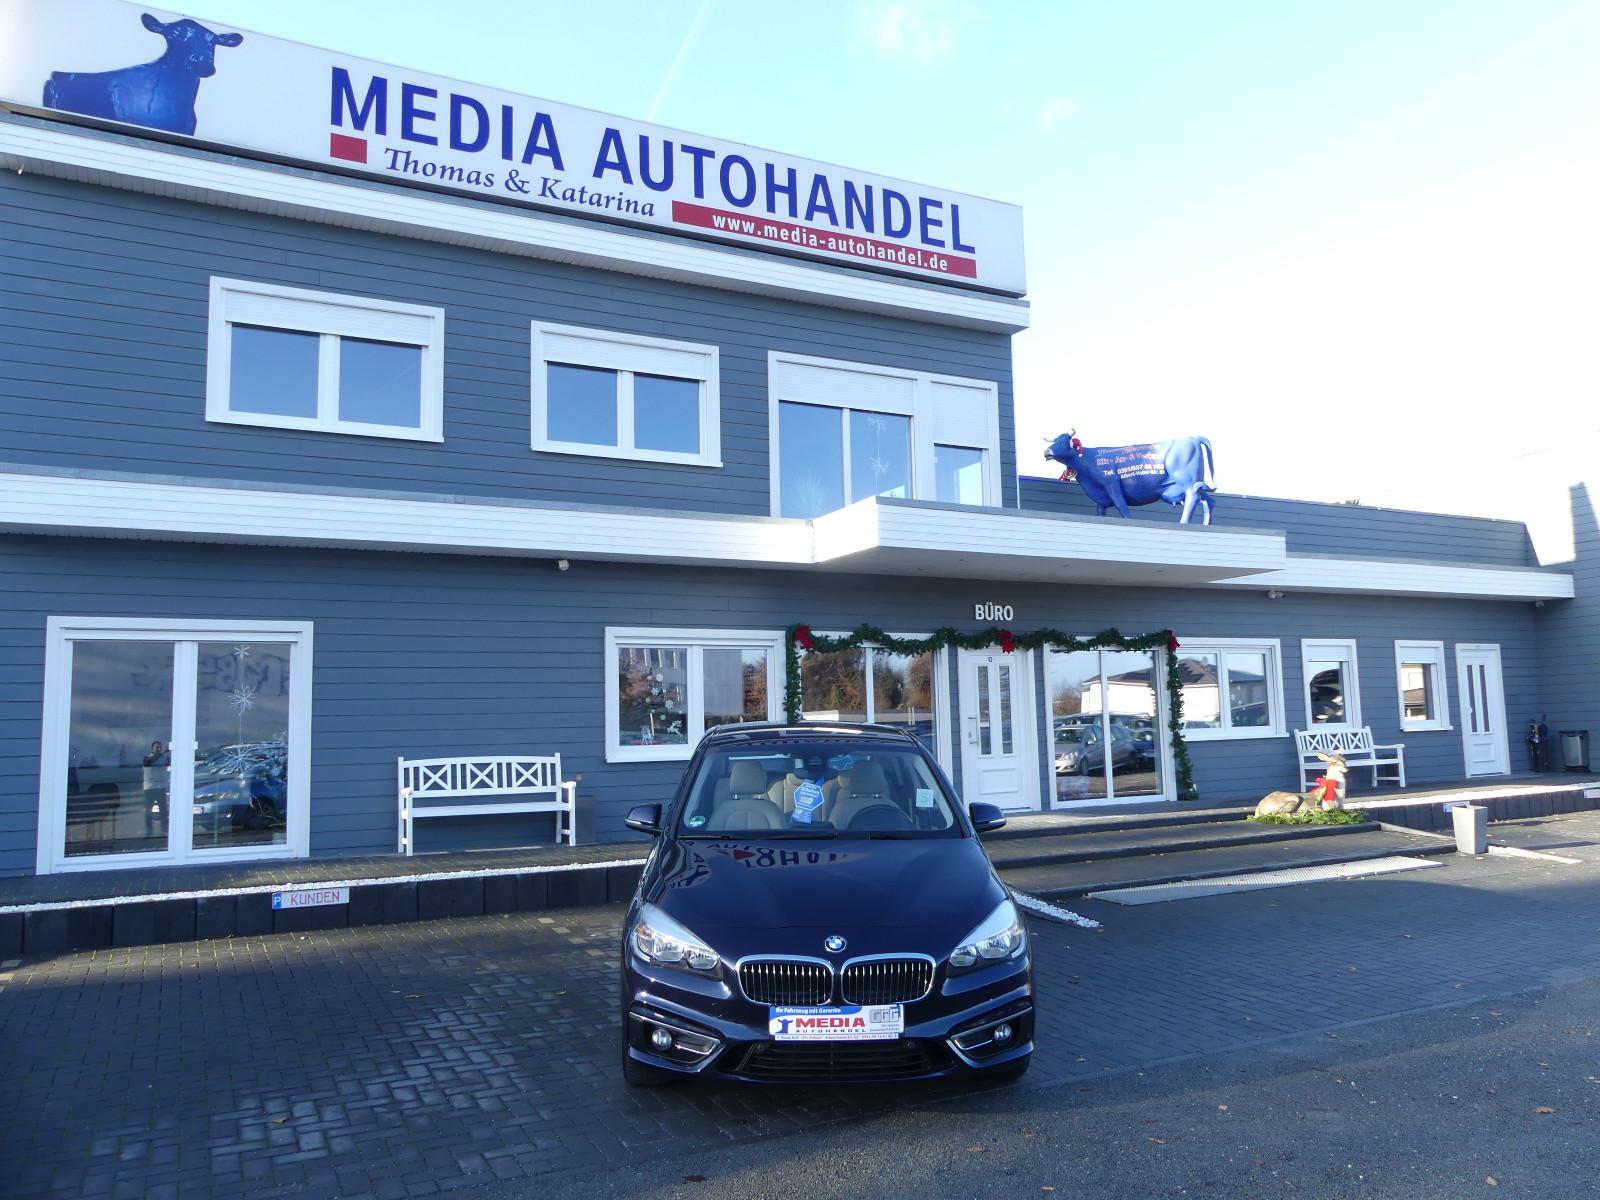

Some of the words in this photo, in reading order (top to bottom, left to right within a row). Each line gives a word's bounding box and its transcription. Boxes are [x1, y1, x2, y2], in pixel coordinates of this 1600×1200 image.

[330, 66, 565, 171] MEDIA
[592, 127, 976, 254] AUTOHANDEL
[385, 147, 495, 188] Thomas
[504, 169, 531, 194] &
[538, 176, 655, 217] Katarina
[712, 214, 949, 272] www.media-autohandel.de
[975, 601, 1014, 621] BÜRO
[290, 891, 340, 906] KUNDEN
[784, 1007, 808, 1015] Fahrzeug
[796, 1017, 866, 1028] MEDIA
